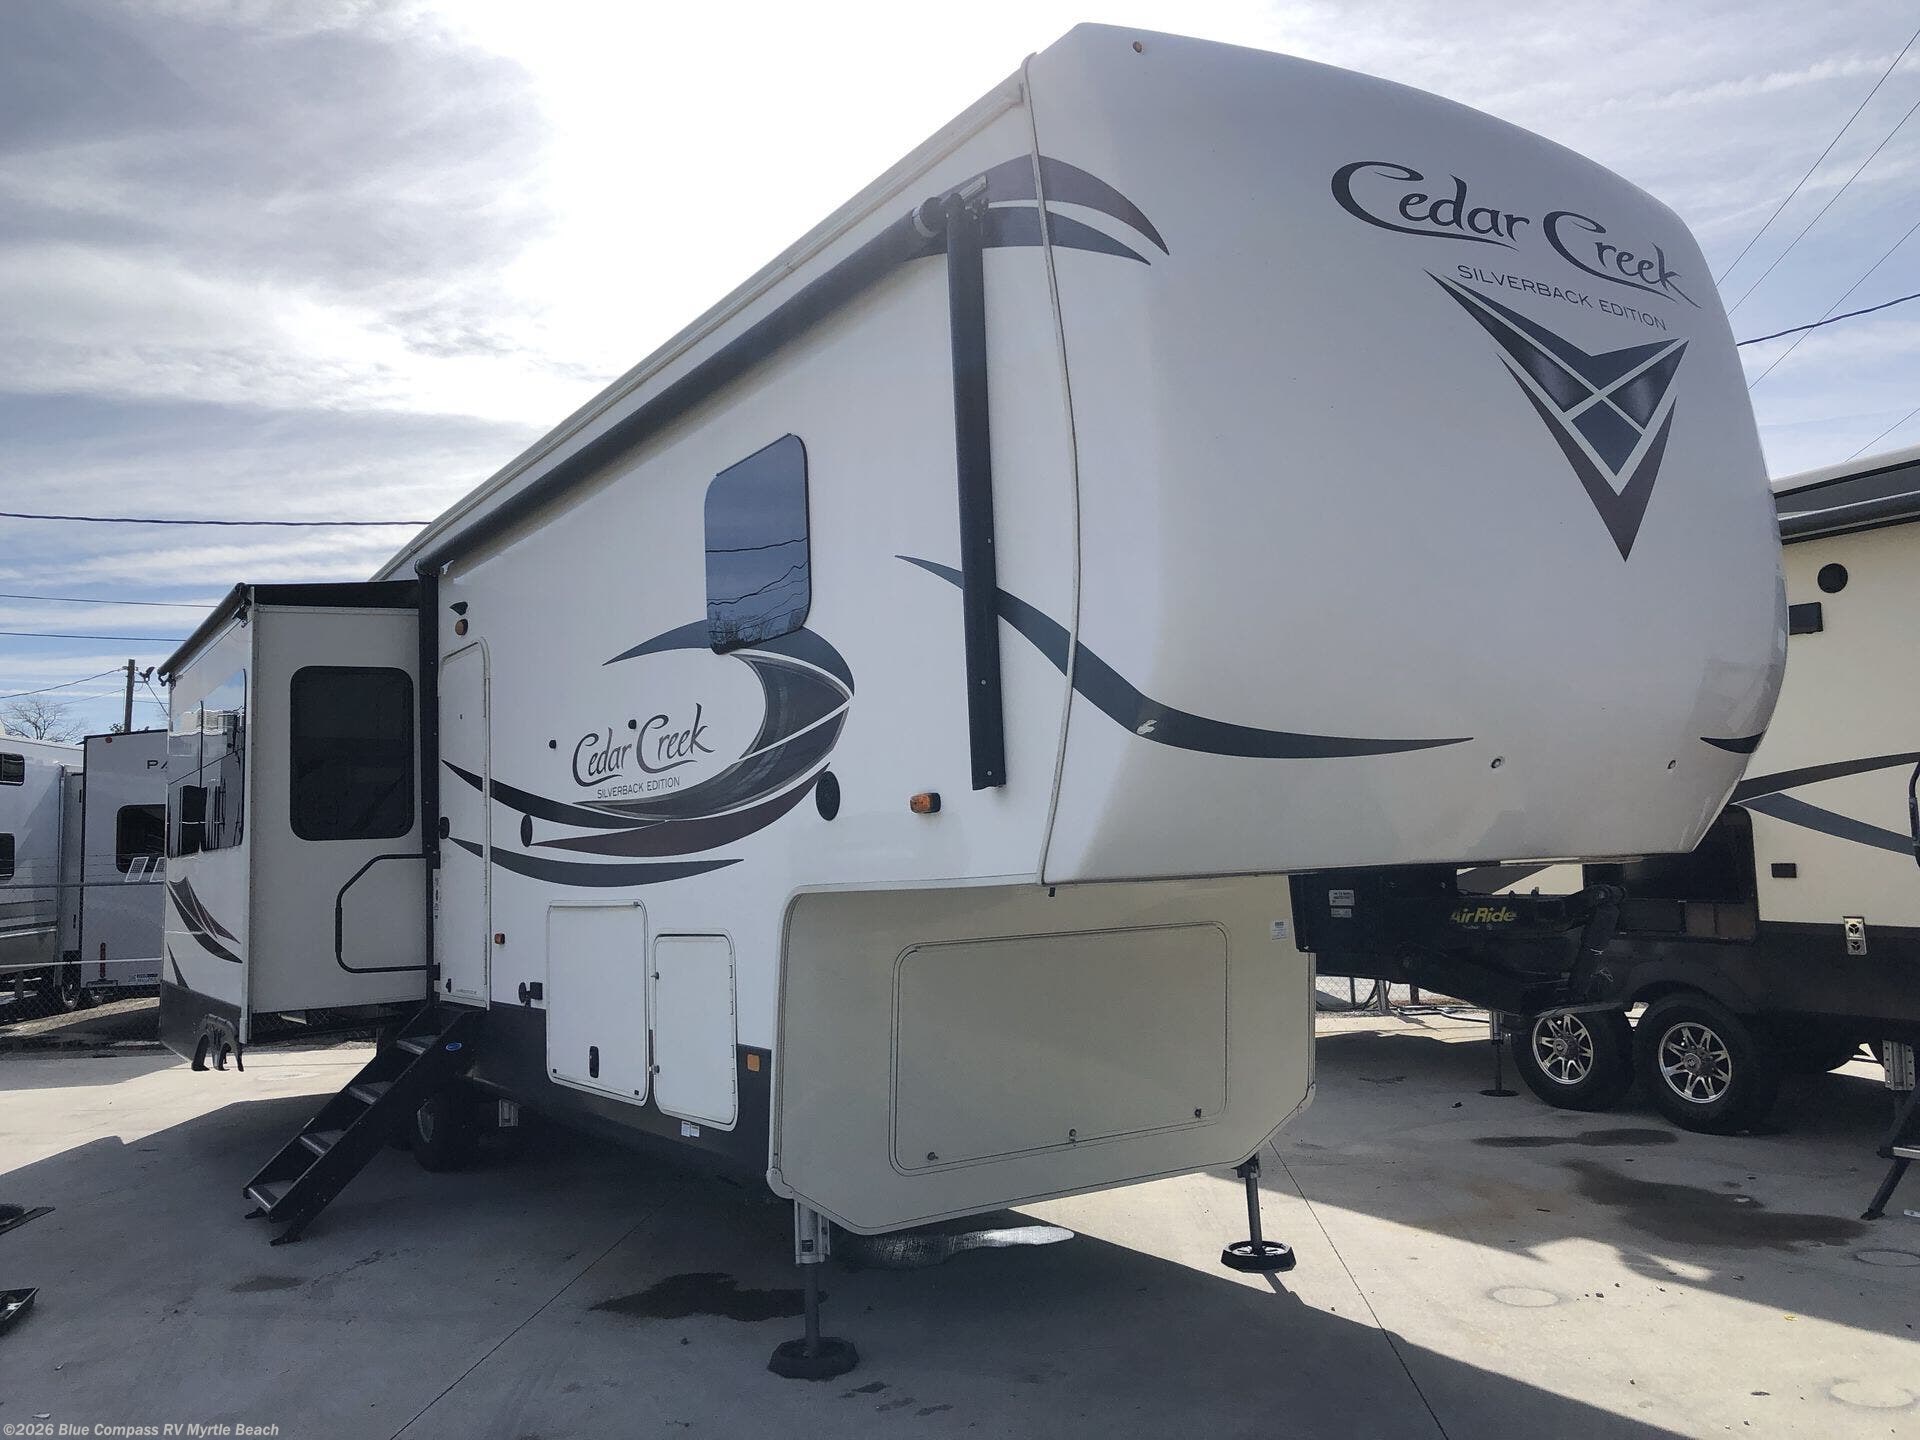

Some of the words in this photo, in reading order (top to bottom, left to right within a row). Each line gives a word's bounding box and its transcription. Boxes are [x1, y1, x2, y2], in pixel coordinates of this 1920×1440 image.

[1331, 161, 1530, 252] Cedar
[1543, 210, 1703, 310] Creek
[1457, 264, 1593, 308] SILVERBACK
[1599, 298, 1667, 331] EDITION
[572, 727, 632, 787] Cedar
[636, 702, 716, 774] Creek
[597, 782, 644, 799] SILVERBACK
[646, 776, 680, 791] EDITION
